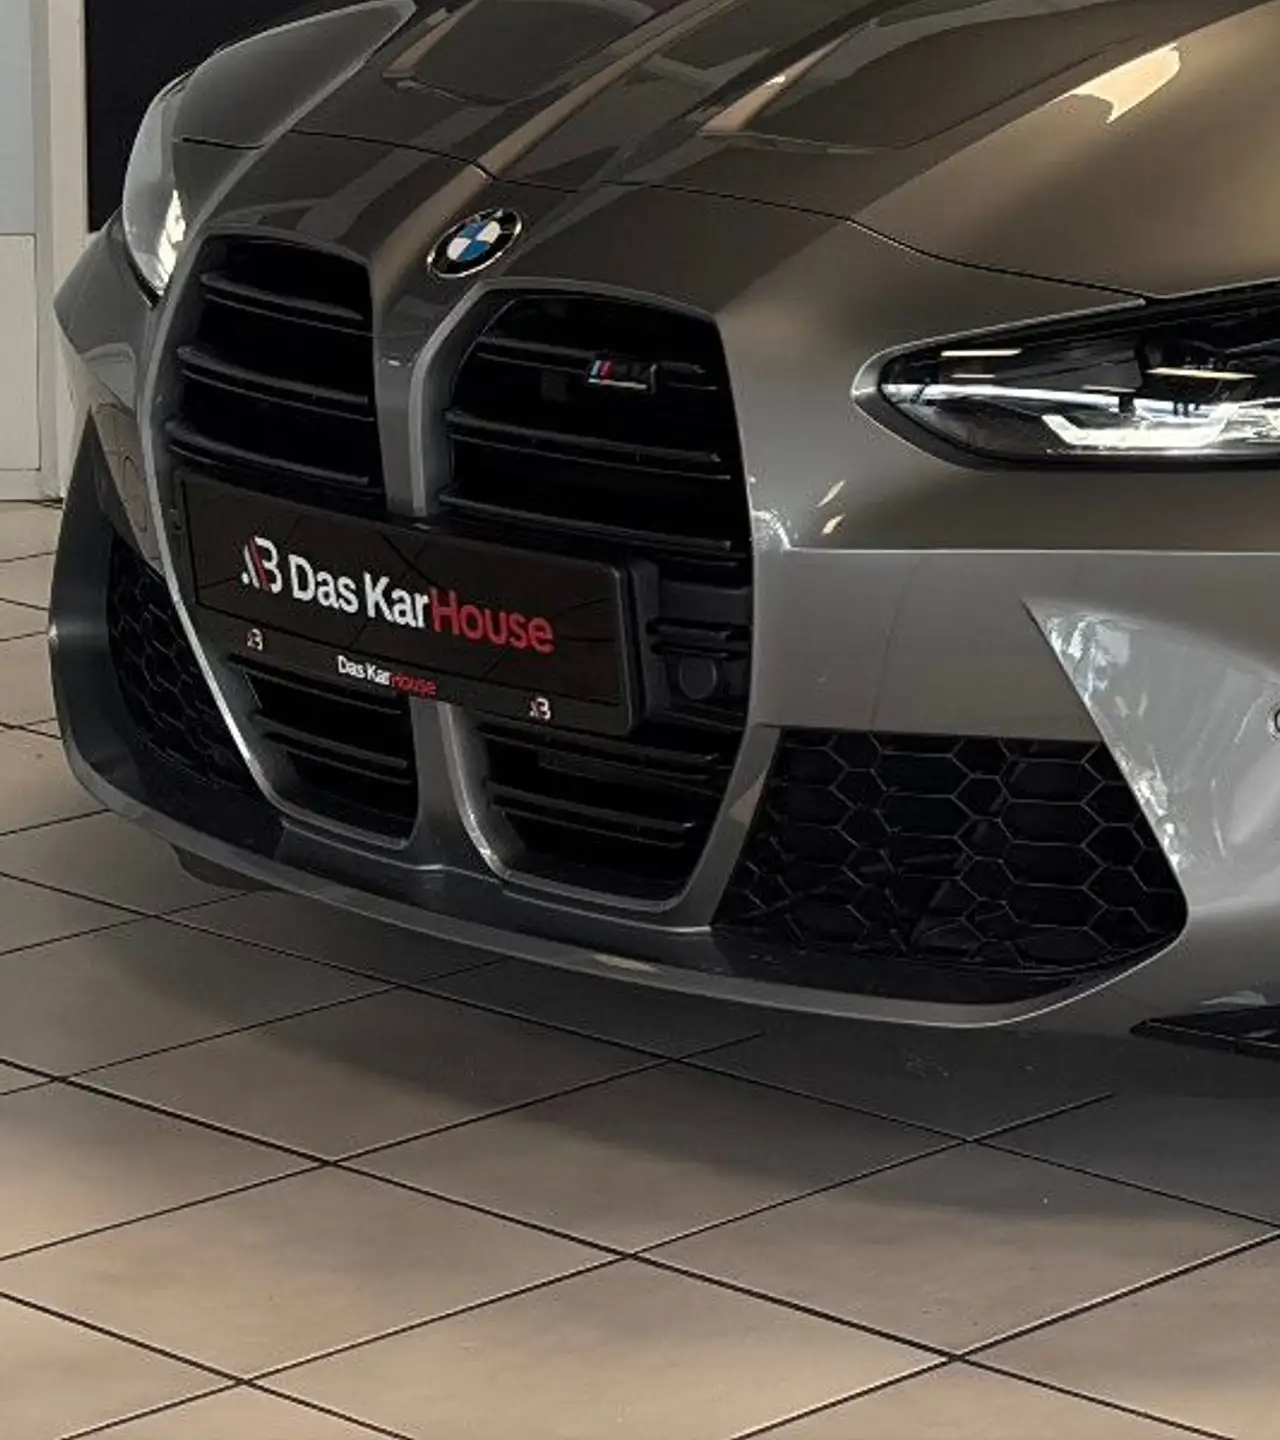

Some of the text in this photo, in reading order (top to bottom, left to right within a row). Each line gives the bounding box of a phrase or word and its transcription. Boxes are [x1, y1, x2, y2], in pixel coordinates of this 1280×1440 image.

[287, 553, 360, 614] Das
[363, 571, 556, 655] KarHouse
[336, 654, 438, 698] Das KarHouse
